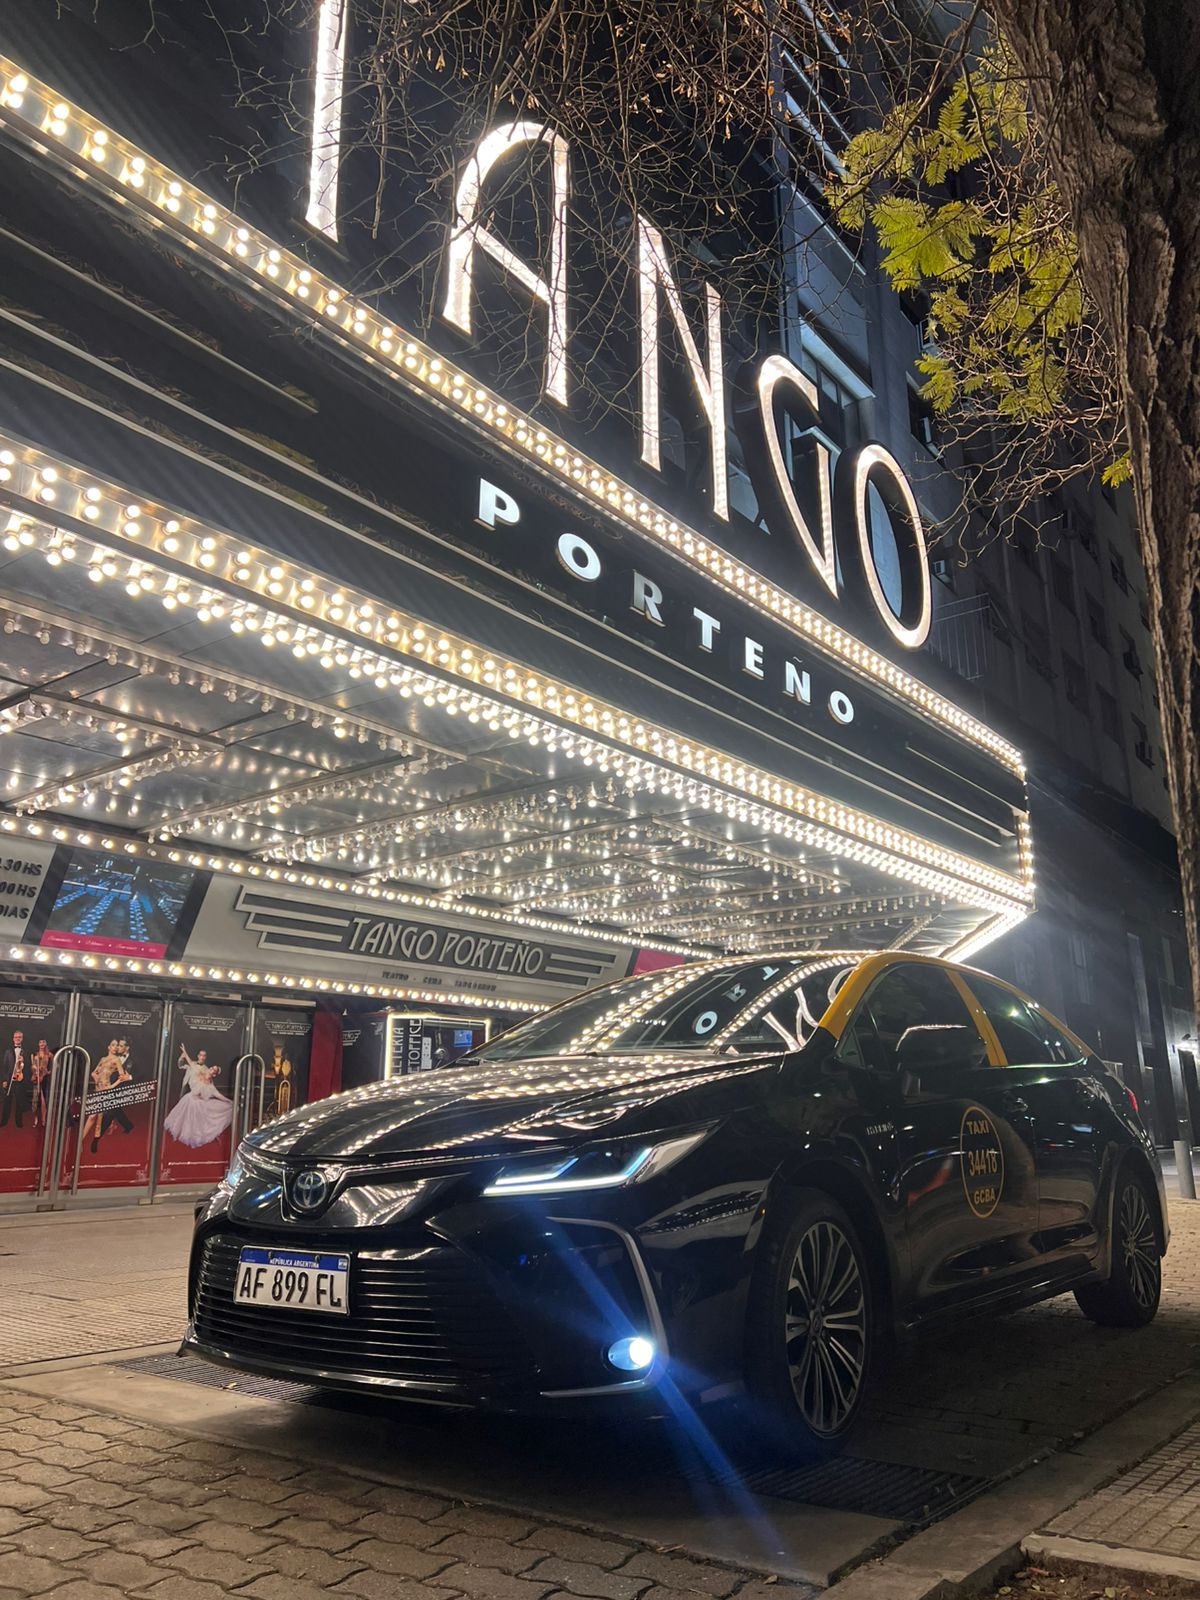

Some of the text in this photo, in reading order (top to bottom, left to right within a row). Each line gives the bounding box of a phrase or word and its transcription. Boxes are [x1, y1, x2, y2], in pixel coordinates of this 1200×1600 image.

[474, 477, 855, 725] PORTEÑO
[22, 861, 42, 876] HS
[16, 883, 37, 898] HS
[348, 917, 544, 976] TANGO PORTEÑO
[0, 1004, 18, 1012] ANGO
[392, 1026, 404, 1077] LETERIA
[408, 1018, 422, 1074] ETOFFICE
[966, 1120, 990, 1136] TAXI
[974, 1188, 996, 1205] GCBA
[239, 1267, 342, 1308] AF 899 FL
